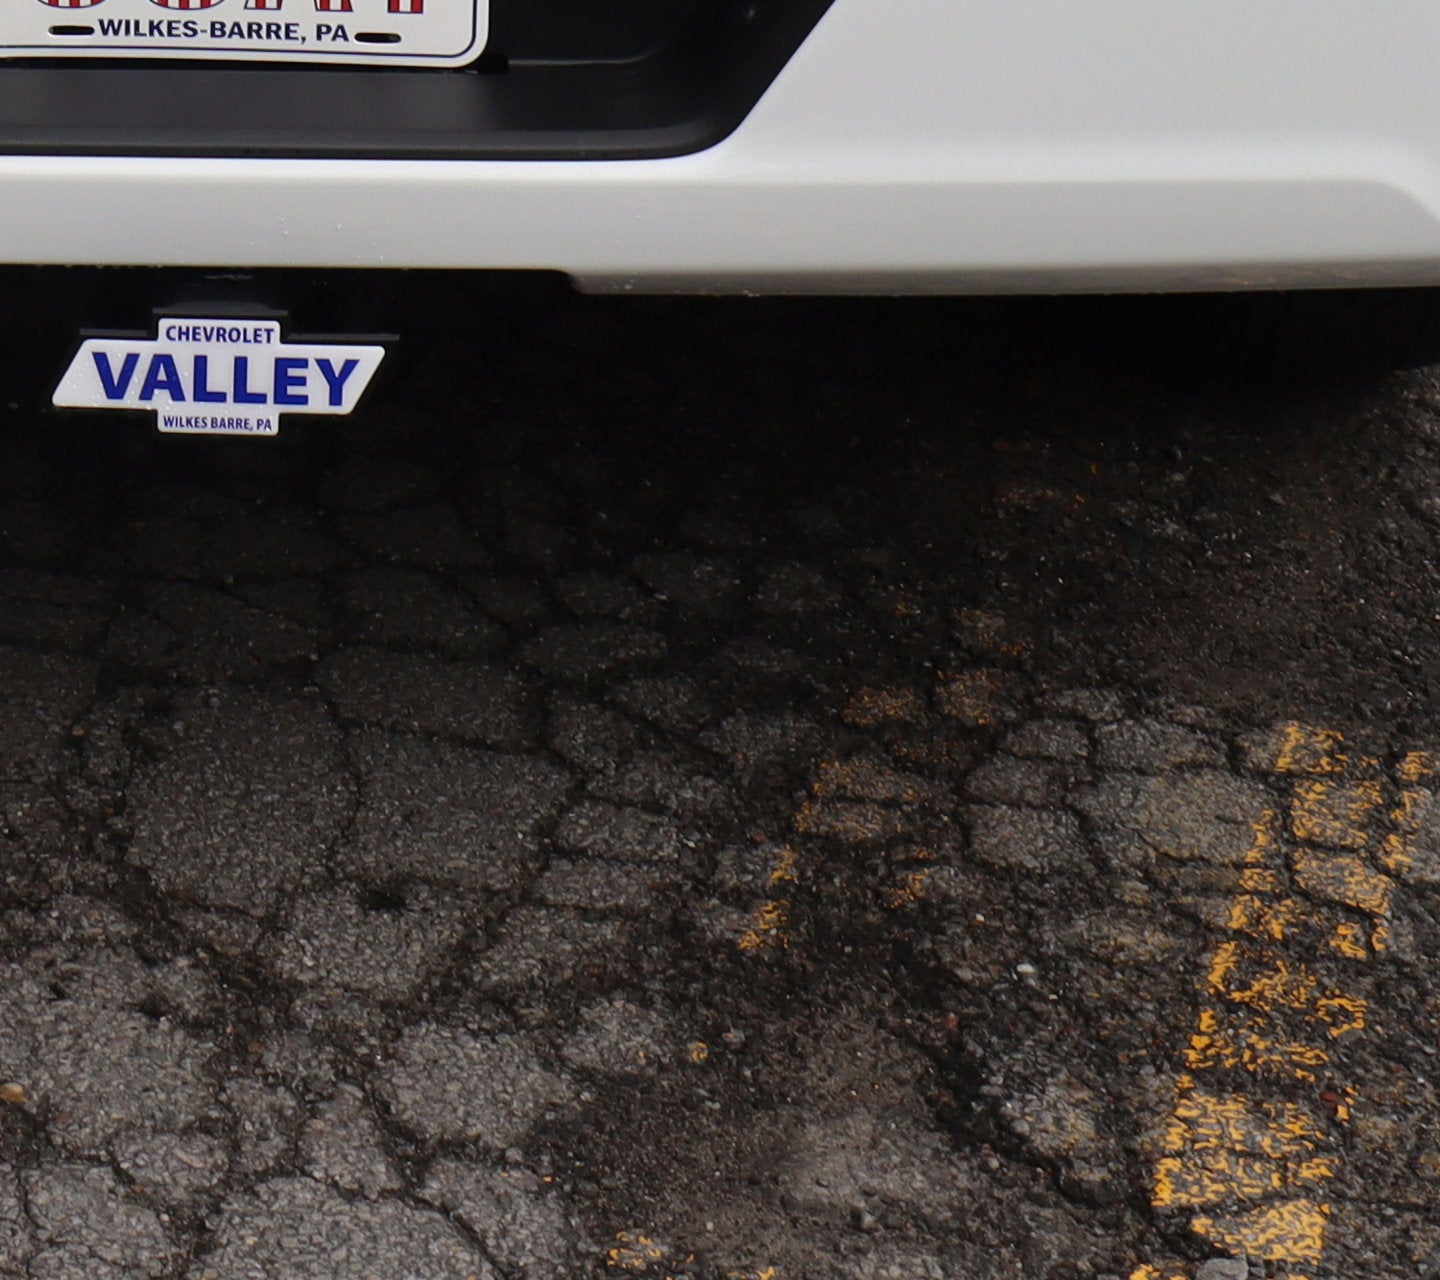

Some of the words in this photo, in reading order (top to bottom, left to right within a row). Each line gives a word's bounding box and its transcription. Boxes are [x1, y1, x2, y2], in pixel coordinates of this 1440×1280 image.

[97, 18, 307, 45] WILKES-BARRE,
[316, 23, 350, 43] PA
[165, 325, 275, 344] CHEVROLET
[91, 351, 360, 407] VALLEY
[163, 415, 208, 429] WILKES
[210, 417, 254, 432] BARRE,
[257, 418, 272, 431] PA
